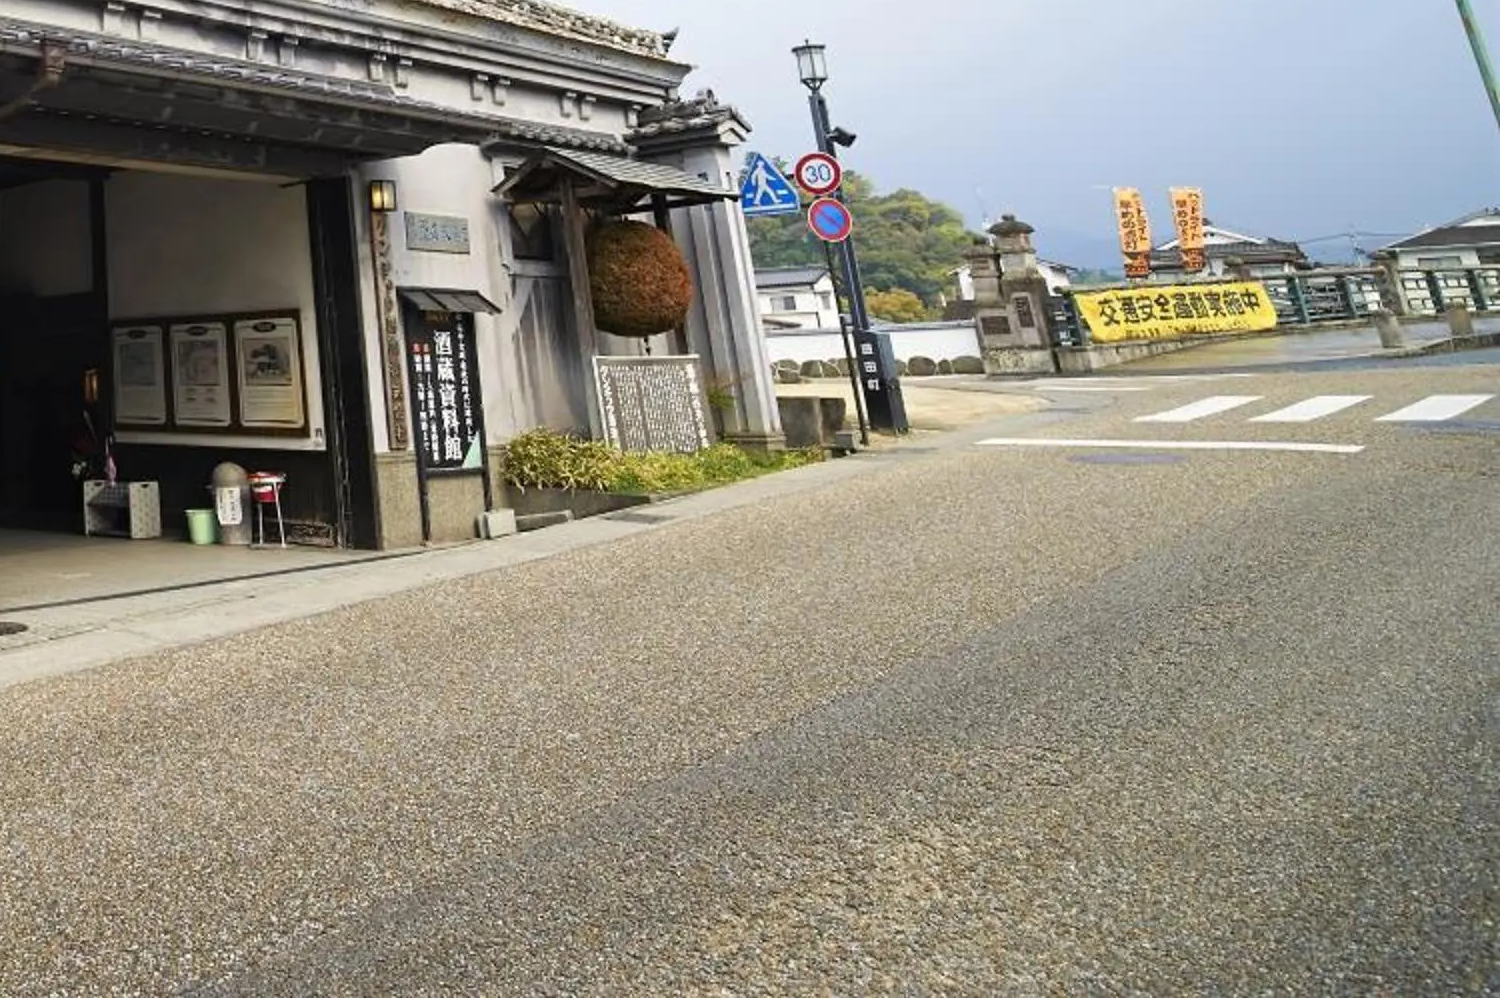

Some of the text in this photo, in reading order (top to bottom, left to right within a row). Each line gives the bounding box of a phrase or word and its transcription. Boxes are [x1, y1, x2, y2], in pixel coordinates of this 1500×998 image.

[806, 164, 831, 183] 30
[1098, 288, 1261, 327] 交通安全運動実施中
[433, 329, 463, 461] 酒蔵資料館
